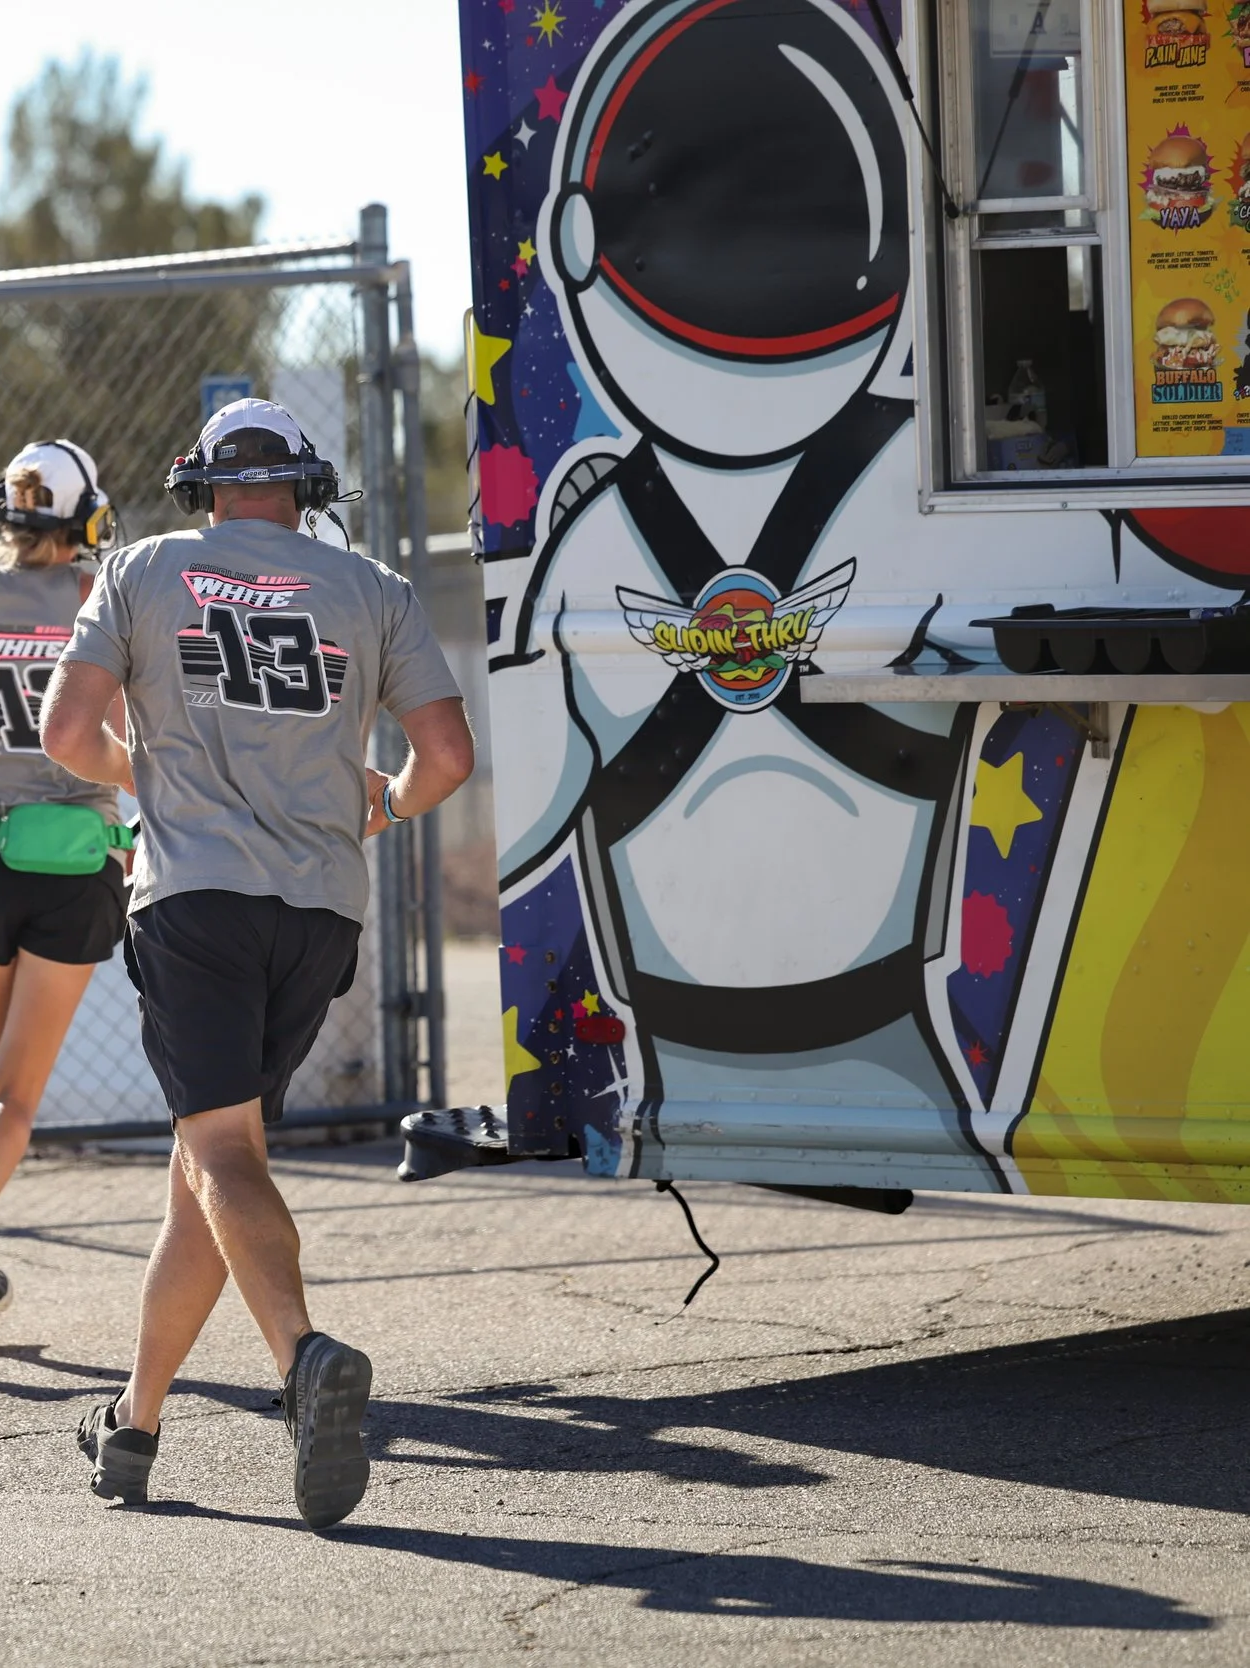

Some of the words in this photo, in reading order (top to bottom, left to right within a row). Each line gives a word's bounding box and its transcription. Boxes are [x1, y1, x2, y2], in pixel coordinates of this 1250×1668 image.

[1145, 43, 1177, 68] PLAIN
[1176, 45, 1207, 68] JANE
[1160, 206, 1201, 230] YAYA
[1156, 369, 1217, 385] BUFFALO
[1153, 385, 1221, 402] SOLDIER
[189, 562, 259, 584] MADALINN
[193, 576, 295, 608] WHITE
[653, 620, 737, 655] SLIDIN'
[744, 606, 817, 652] THRU
[202, 603, 331, 717] 13
[799, 665, 810, 673] TM
